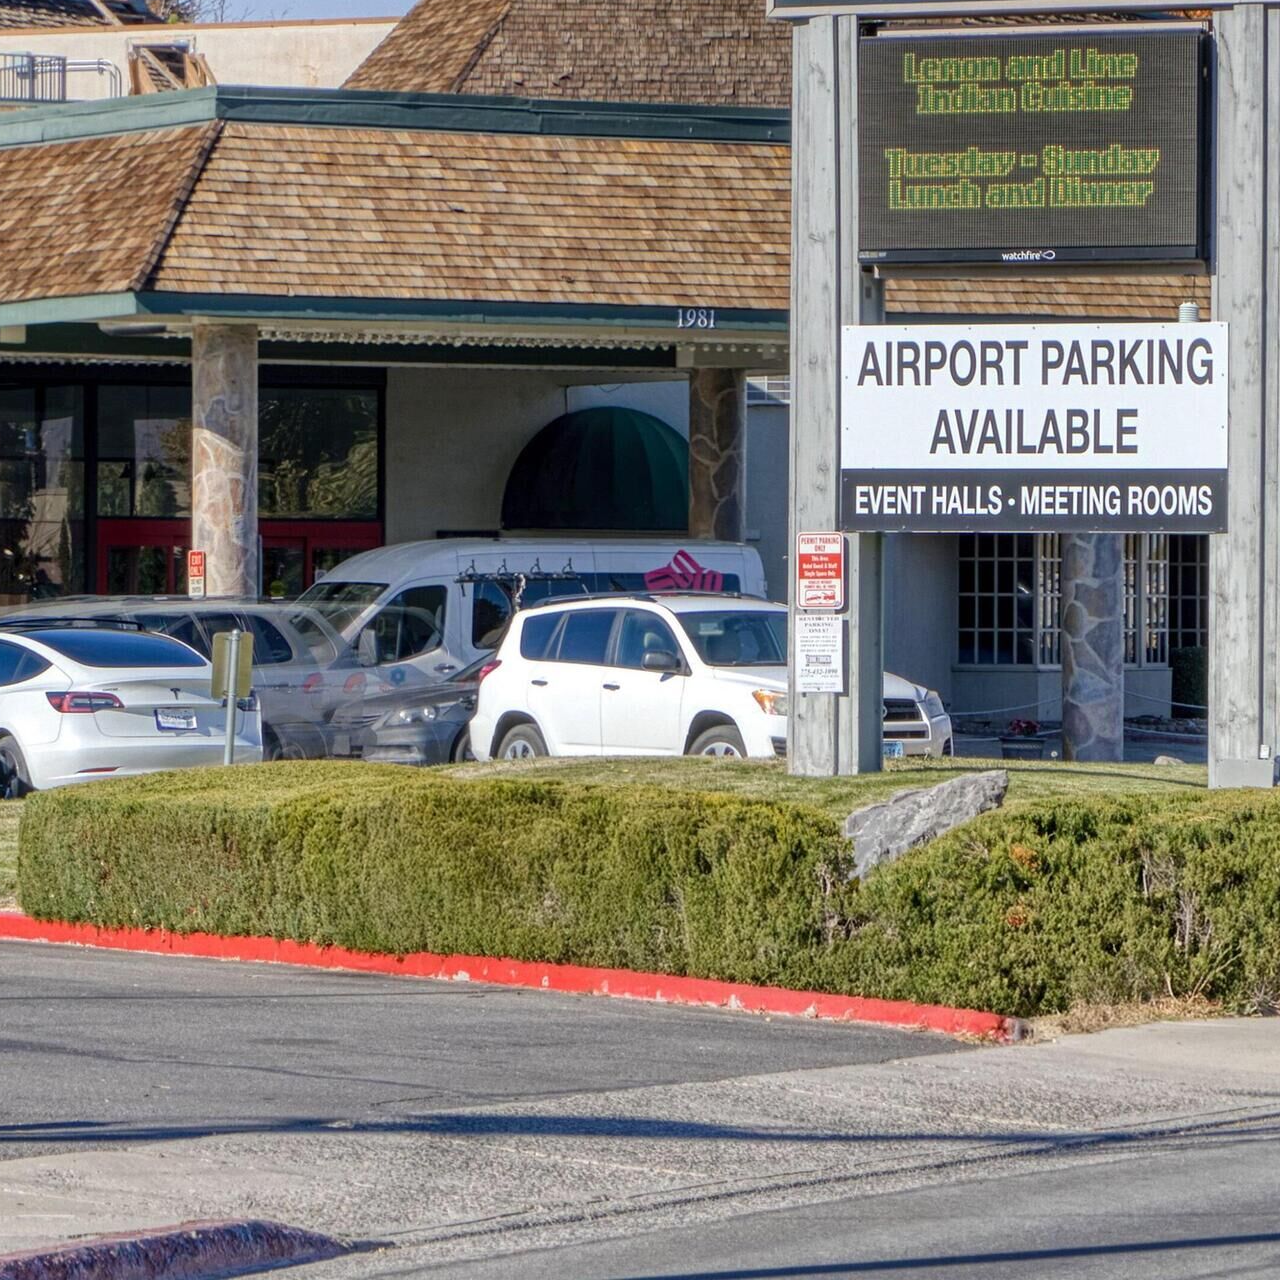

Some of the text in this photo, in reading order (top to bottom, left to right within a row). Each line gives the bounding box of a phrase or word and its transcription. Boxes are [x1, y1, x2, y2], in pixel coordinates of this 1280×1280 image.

[1005, 49, 1065, 80] and
[917, 81, 1133, 114] Indian Cuisine
[885, 147, 1017, 177] Tuesday
[1043, 144, 1160, 175] Sunday
[889, 177, 1154, 209] Lunch and Dinner
[1002, 250, 1040, 261] watchfire
[677, 308, 716, 328] 1981
[857, 337, 1213, 386] AIRPORT PARKING
[929, 408, 1138, 454] AVAILABLE
[855, 486, 926, 515] EVENT
[931, 485, 1002, 515] HALLS
[1021, 485, 1121, 516] MEETING
[1128, 485, 1213, 515] ROOMS
[819, 536, 839, 544] PARKING
